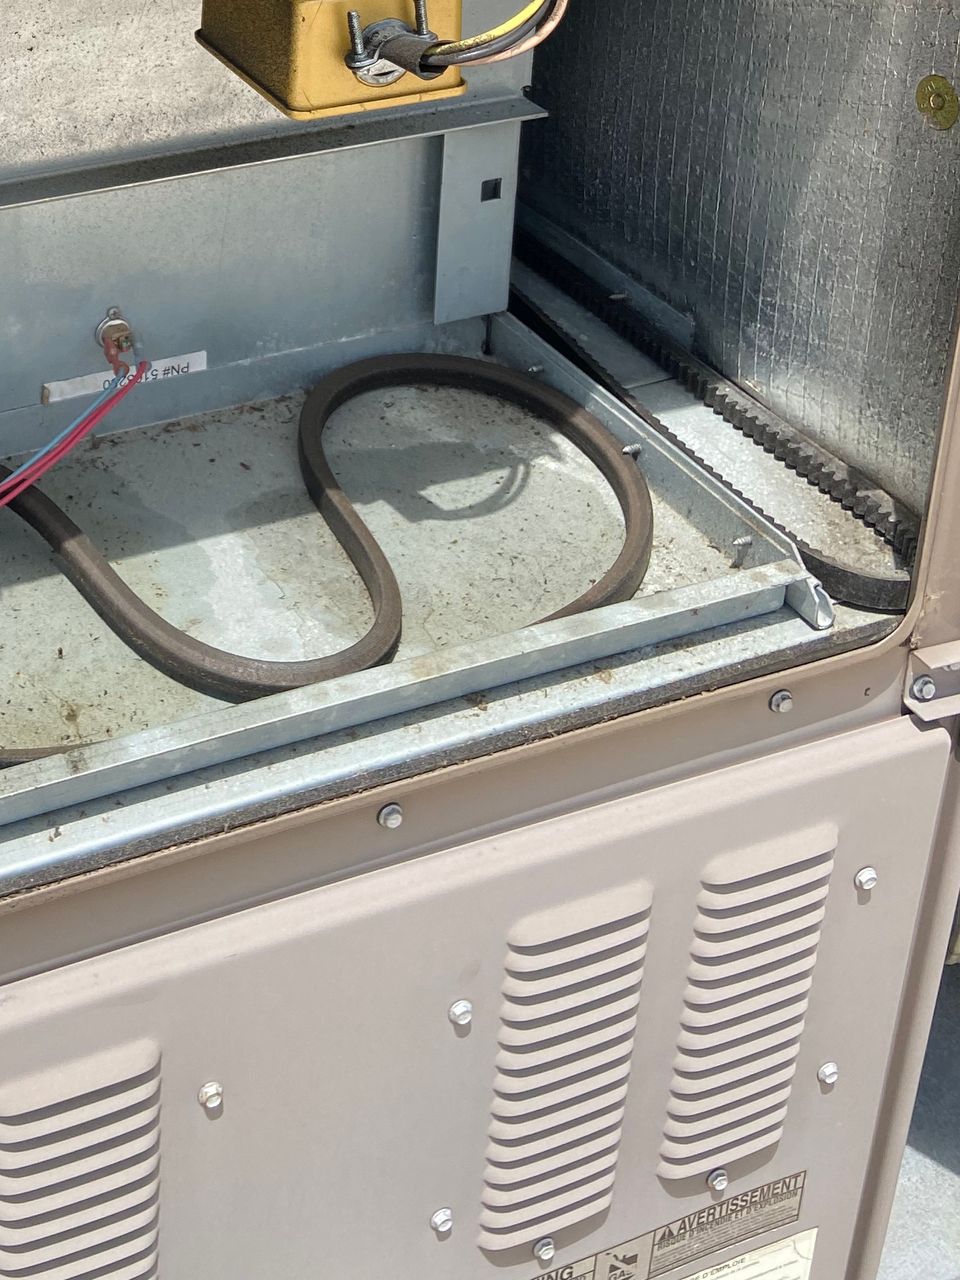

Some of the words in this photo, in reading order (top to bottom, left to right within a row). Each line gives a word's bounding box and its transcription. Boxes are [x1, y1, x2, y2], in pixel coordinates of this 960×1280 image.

[163, 361, 190, 377] PN#
[657, 1232, 688, 1252] RISQUE
[689, 1212, 733, 1238] D'INCENDIE
[734, 1208, 744, 1219] ET
[745, 1189, 798, 1215] D'EXPLOSION
[677, 1174, 802, 1235] AVERTISSEMENT
